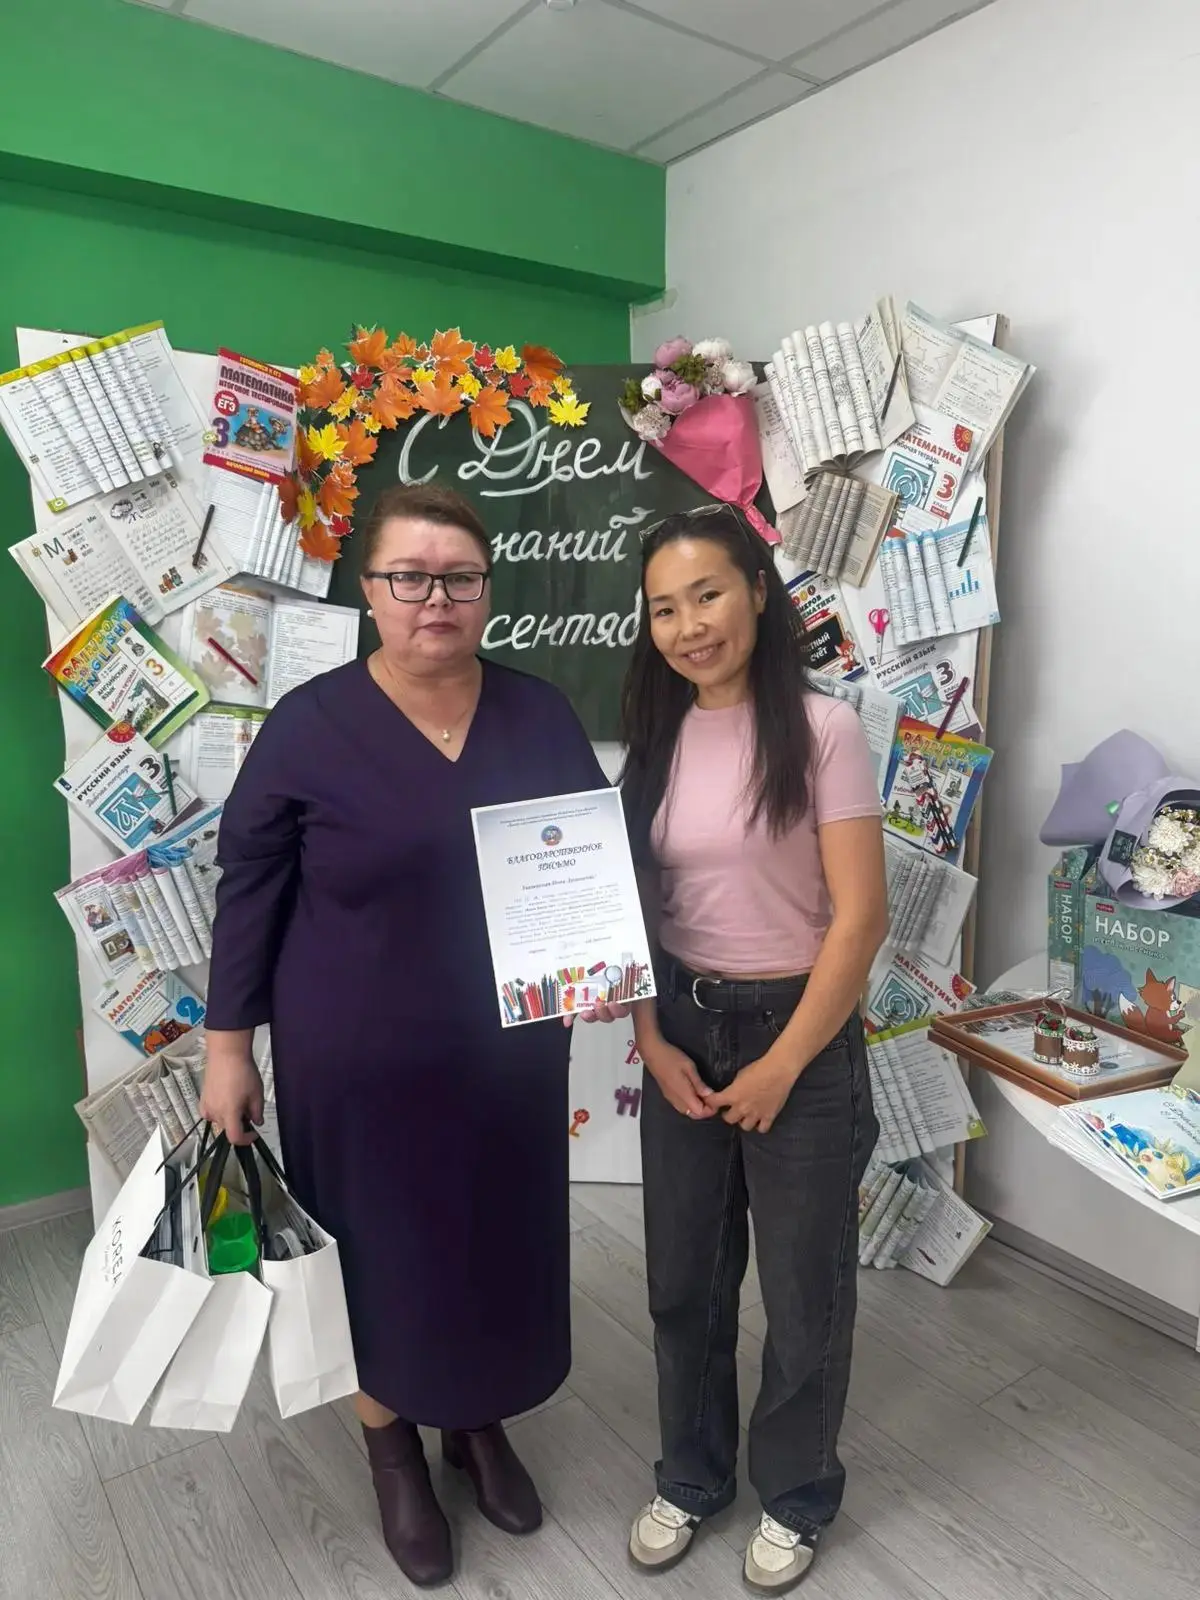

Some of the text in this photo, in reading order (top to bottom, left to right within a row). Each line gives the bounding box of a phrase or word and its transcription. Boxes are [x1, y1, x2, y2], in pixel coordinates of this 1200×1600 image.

[220, 364, 295, 406] МАТЕМАТИКА
[217, 398, 237, 413] ЕГЭ
[211, 416, 231, 449] 3
[398, 411, 451, 487] С
[457, 398, 655, 497] Днем
[936, 472, 956, 500] 3
[490, 506, 655, 564] наний
[480, 586, 643, 650] сентяб
[62, 607, 127, 680] RAINBOW
[74, 622, 126, 694] ENGLISH
[145, 657, 165, 677] 3
[876, 657, 912, 680] РУССКИЙ
[912, 643, 937, 660] ЯЗЫК
[936, 660, 954, 686] 3
[77, 767, 112, 801] РУССКИЙ
[110, 746, 133, 769] ЯЗЫК
[139, 757, 162, 780] 3
[506, 842, 604, 865] БЛАГОДАРСТВЕННОЕ
[537, 858, 577, 872] ПИСЬМО
[1061, 893, 1073, 945] НАБОР
[1095, 915, 1171, 949] НАБОР
[581, 986, 590, 1002] 1
[894, 952, 957, 1011] МАТЕМАТИКА
[175, 995, 206, 1026] 2
